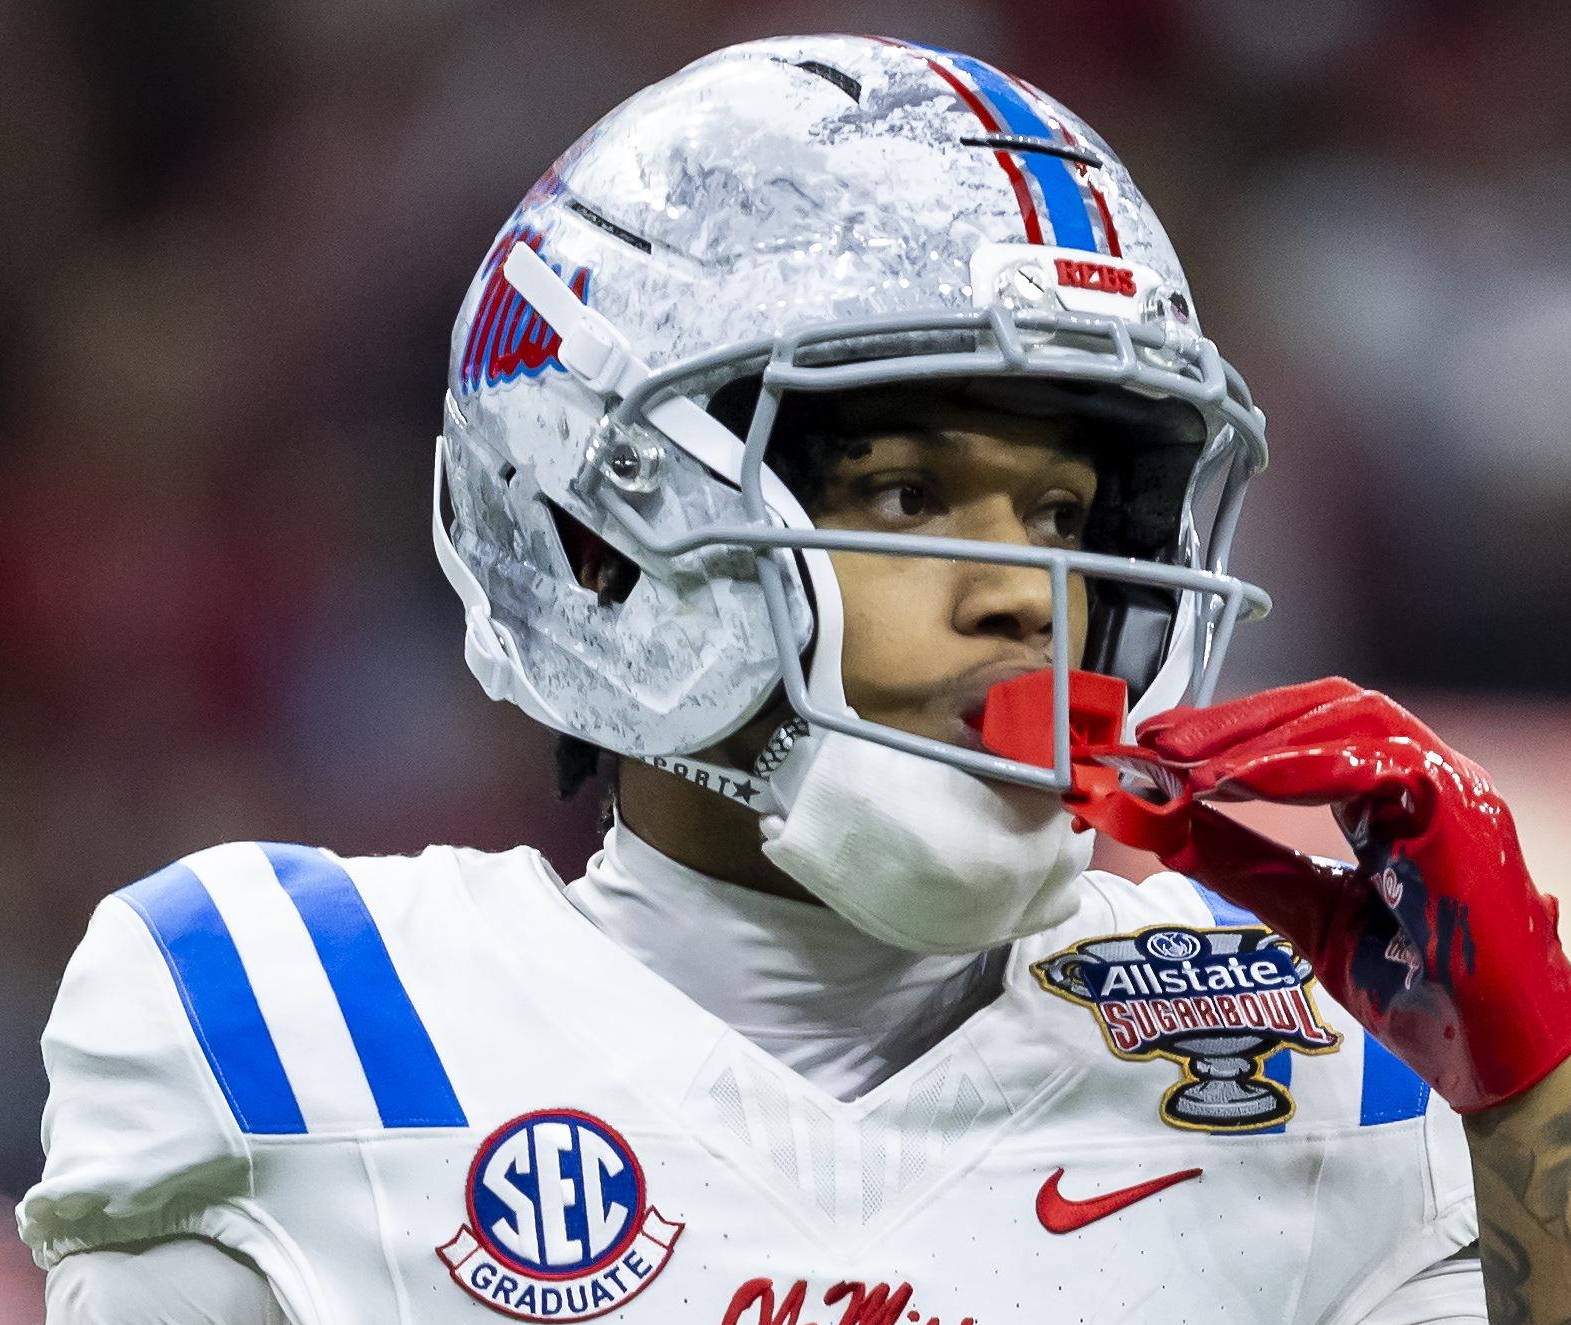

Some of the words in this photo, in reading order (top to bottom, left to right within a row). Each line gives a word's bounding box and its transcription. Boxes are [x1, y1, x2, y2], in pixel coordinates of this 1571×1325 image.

[1053, 257, 1138, 298] REBS
[481, 1120, 629, 1268] SEC
[469, 1249, 654, 1316] GRADUATE
